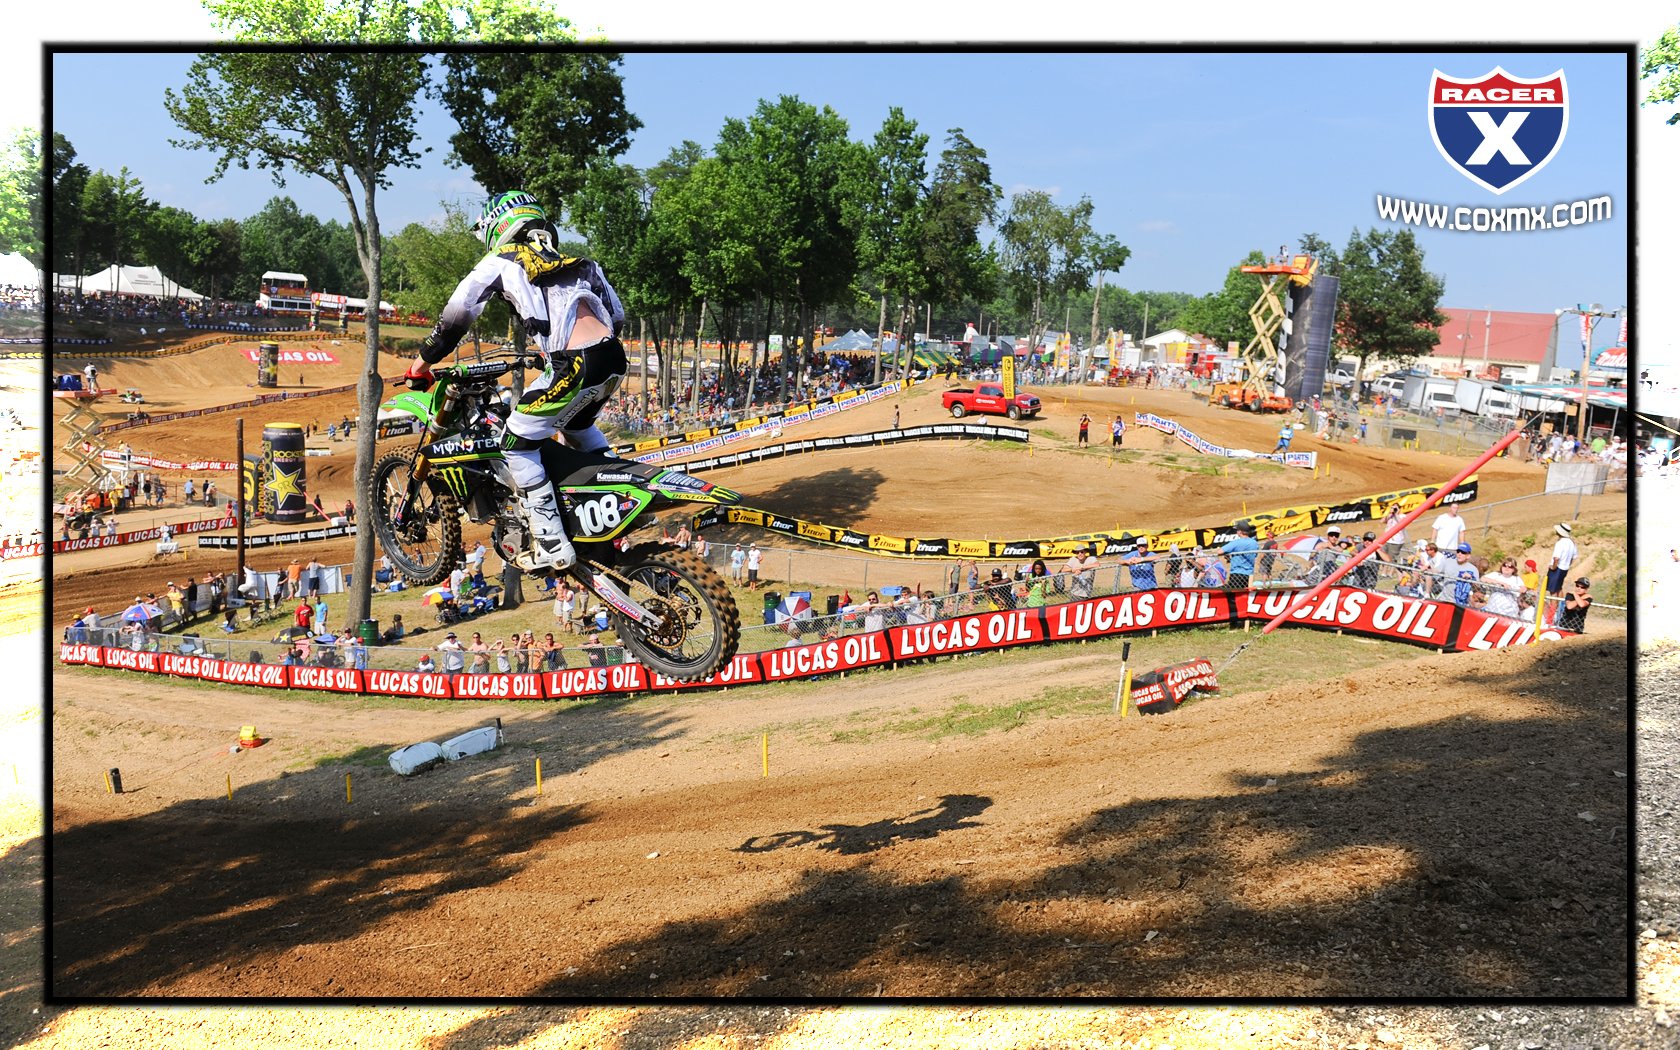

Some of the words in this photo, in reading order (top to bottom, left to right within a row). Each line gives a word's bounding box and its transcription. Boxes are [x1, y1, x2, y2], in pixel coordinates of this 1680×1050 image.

[306, 351, 333, 361] OIL
[597, 473, 633, 481] Kawasaki
[575, 494, 621, 537] 108
[740, 515, 759, 523] thor
[1327, 510, 1363, 521] thor
[186, 519, 217, 532] LUCAS
[772, 520, 793, 530] thor
[128, 529, 161, 543] LUCAS
[807, 528, 826, 537] thor
[841, 535, 864, 544] thor
[1214, 534, 1240, 544] tho
[64, 537, 100, 551] LUCAS
[103, 535, 120, 546] OIL
[880, 540, 899, 548] thor
[917, 543, 943, 552] thor
[1003, 547, 1033, 556] thor
[1057, 593, 1154, 636] LUCAS
[1164, 592, 1217, 622] OIL
[1247, 589, 1367, 625] LUCAS
[1372, 598, 1437, 638] OIL
[900, 621, 980, 655] LUCAS
[988, 612, 1032, 643] OIL
[87, 647, 99, 662] OIL
[107, 649, 136, 668] LUCAS
[138, 653, 155, 671] OIL
[771, 642, 838, 676] LUCAS
[844, 635, 881, 665] OIL
[164, 657, 199, 675] LUCAS
[201, 661, 221, 679] OIL
[223, 663, 261, 684] LUCAS
[262, 664, 283, 684] OIL
[1168, 667, 1198, 686] LUCAS
[1197, 663, 1212, 675] OIL
[294, 668, 334, 688] LUCAS
[339, 671, 357, 689] OIL
[371, 671, 418, 693] LUCAS
[423, 675, 445, 695] OIL
[459, 675, 509, 696] LUCAS
[513, 675, 537, 696] OIL
[551, 668, 608, 695] LUCAS
[612, 665, 640, 688] OIL
[1132, 687, 1148, 698] LUCAS
[1150, 685, 1160, 693] OIL
[1152, 692, 1163, 700] OIL
